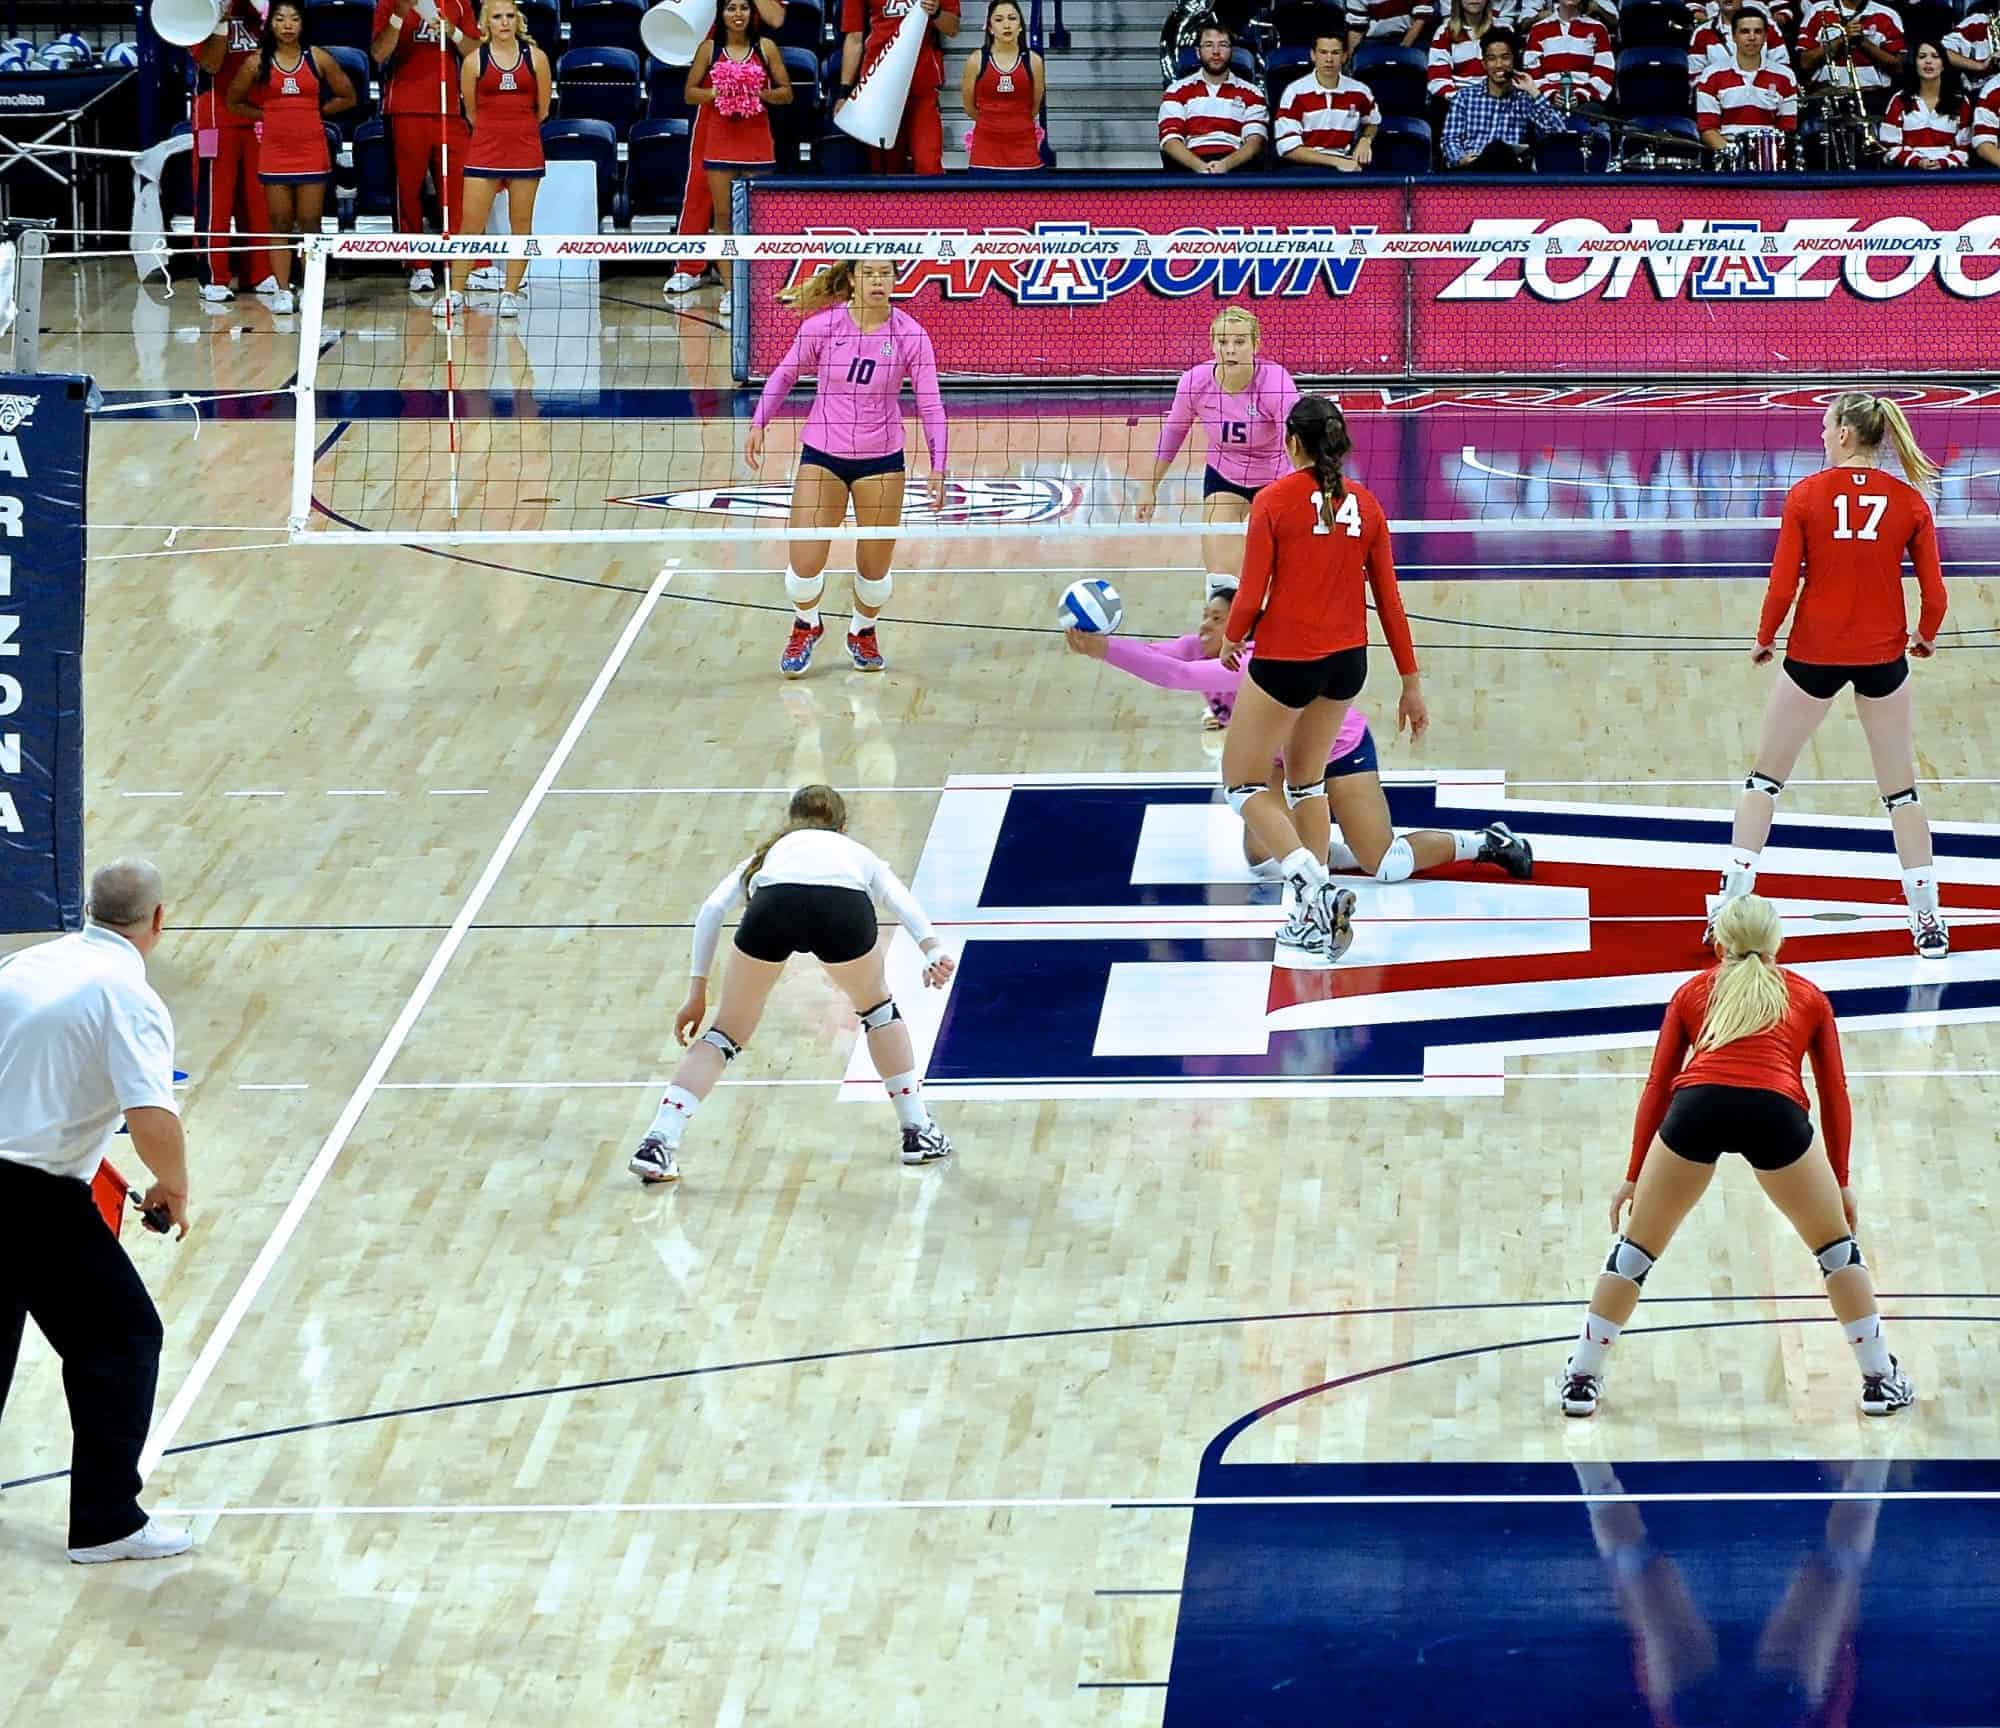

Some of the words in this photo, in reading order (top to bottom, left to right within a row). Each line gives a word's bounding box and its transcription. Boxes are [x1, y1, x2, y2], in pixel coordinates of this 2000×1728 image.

[846, 357, 876, 385] 10
[1221, 420, 1248, 444] 15
[1850, 472, 1868, 486] U
[1310, 489, 1362, 538] 14
[1832, 494, 1889, 541] 17
